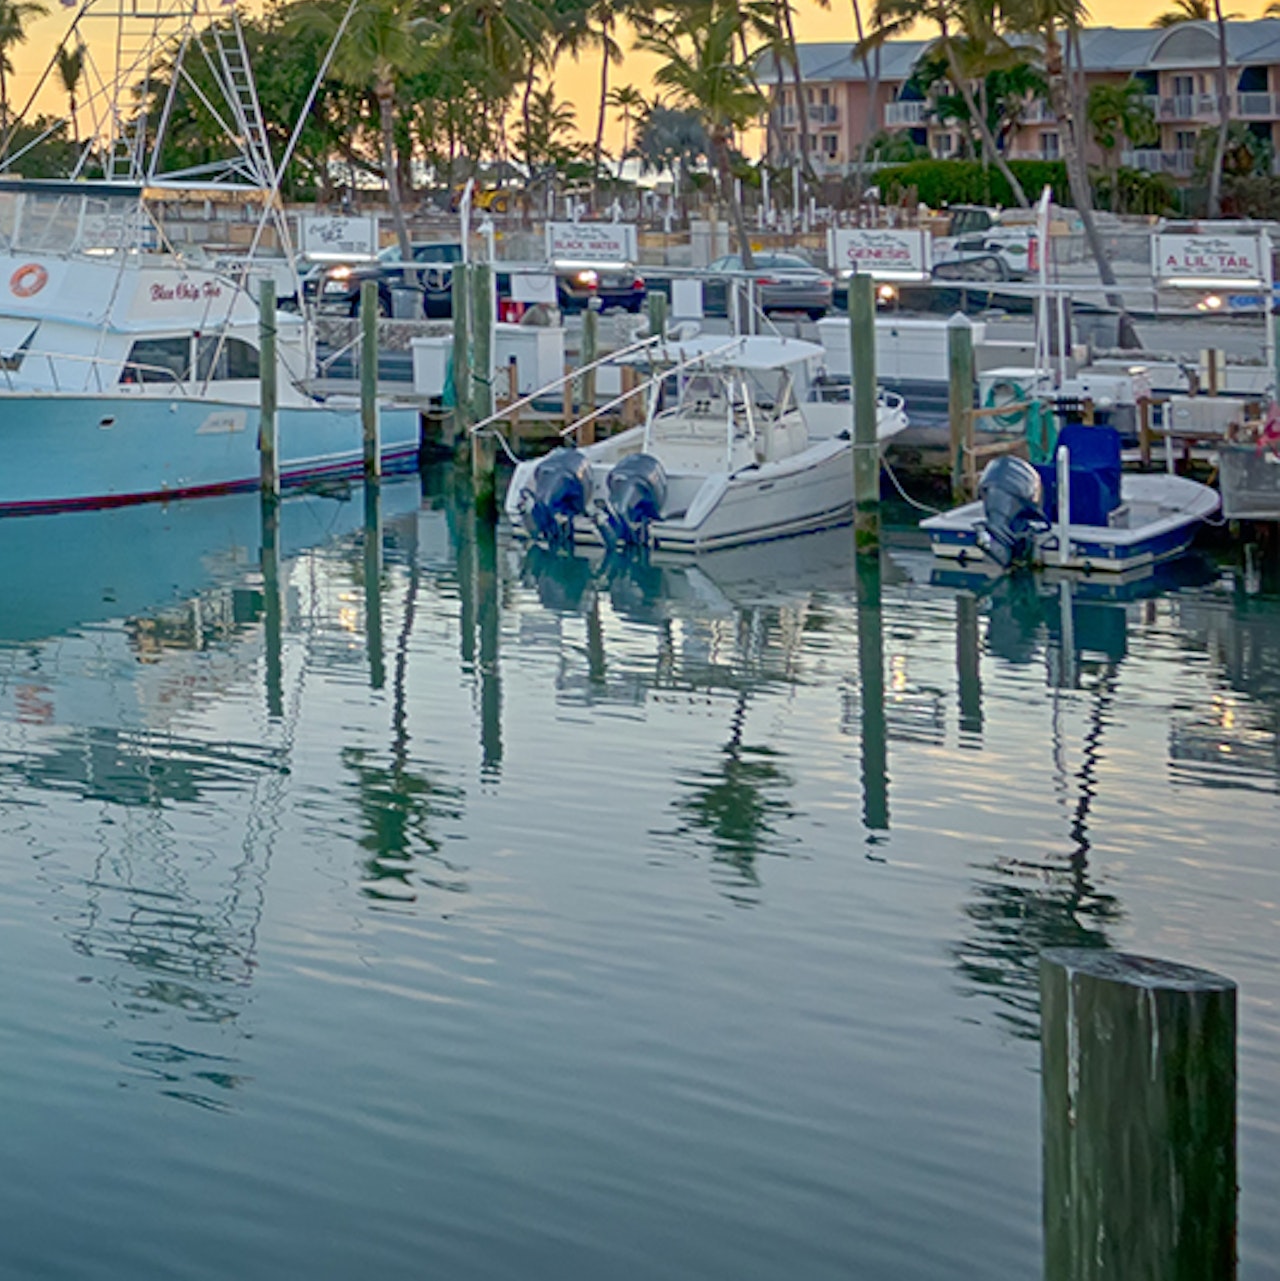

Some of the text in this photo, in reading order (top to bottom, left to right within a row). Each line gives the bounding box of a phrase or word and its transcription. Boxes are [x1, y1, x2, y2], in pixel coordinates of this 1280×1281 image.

[554, 241, 619, 250] BLACK WATER
[847, 248, 910, 259] GENESIS
[1166, 255, 1178, 266] A
[1218, 256, 1253, 268] TAIL
[150, 283, 174, 300] Blue
[176, 282, 200, 302] Chip
